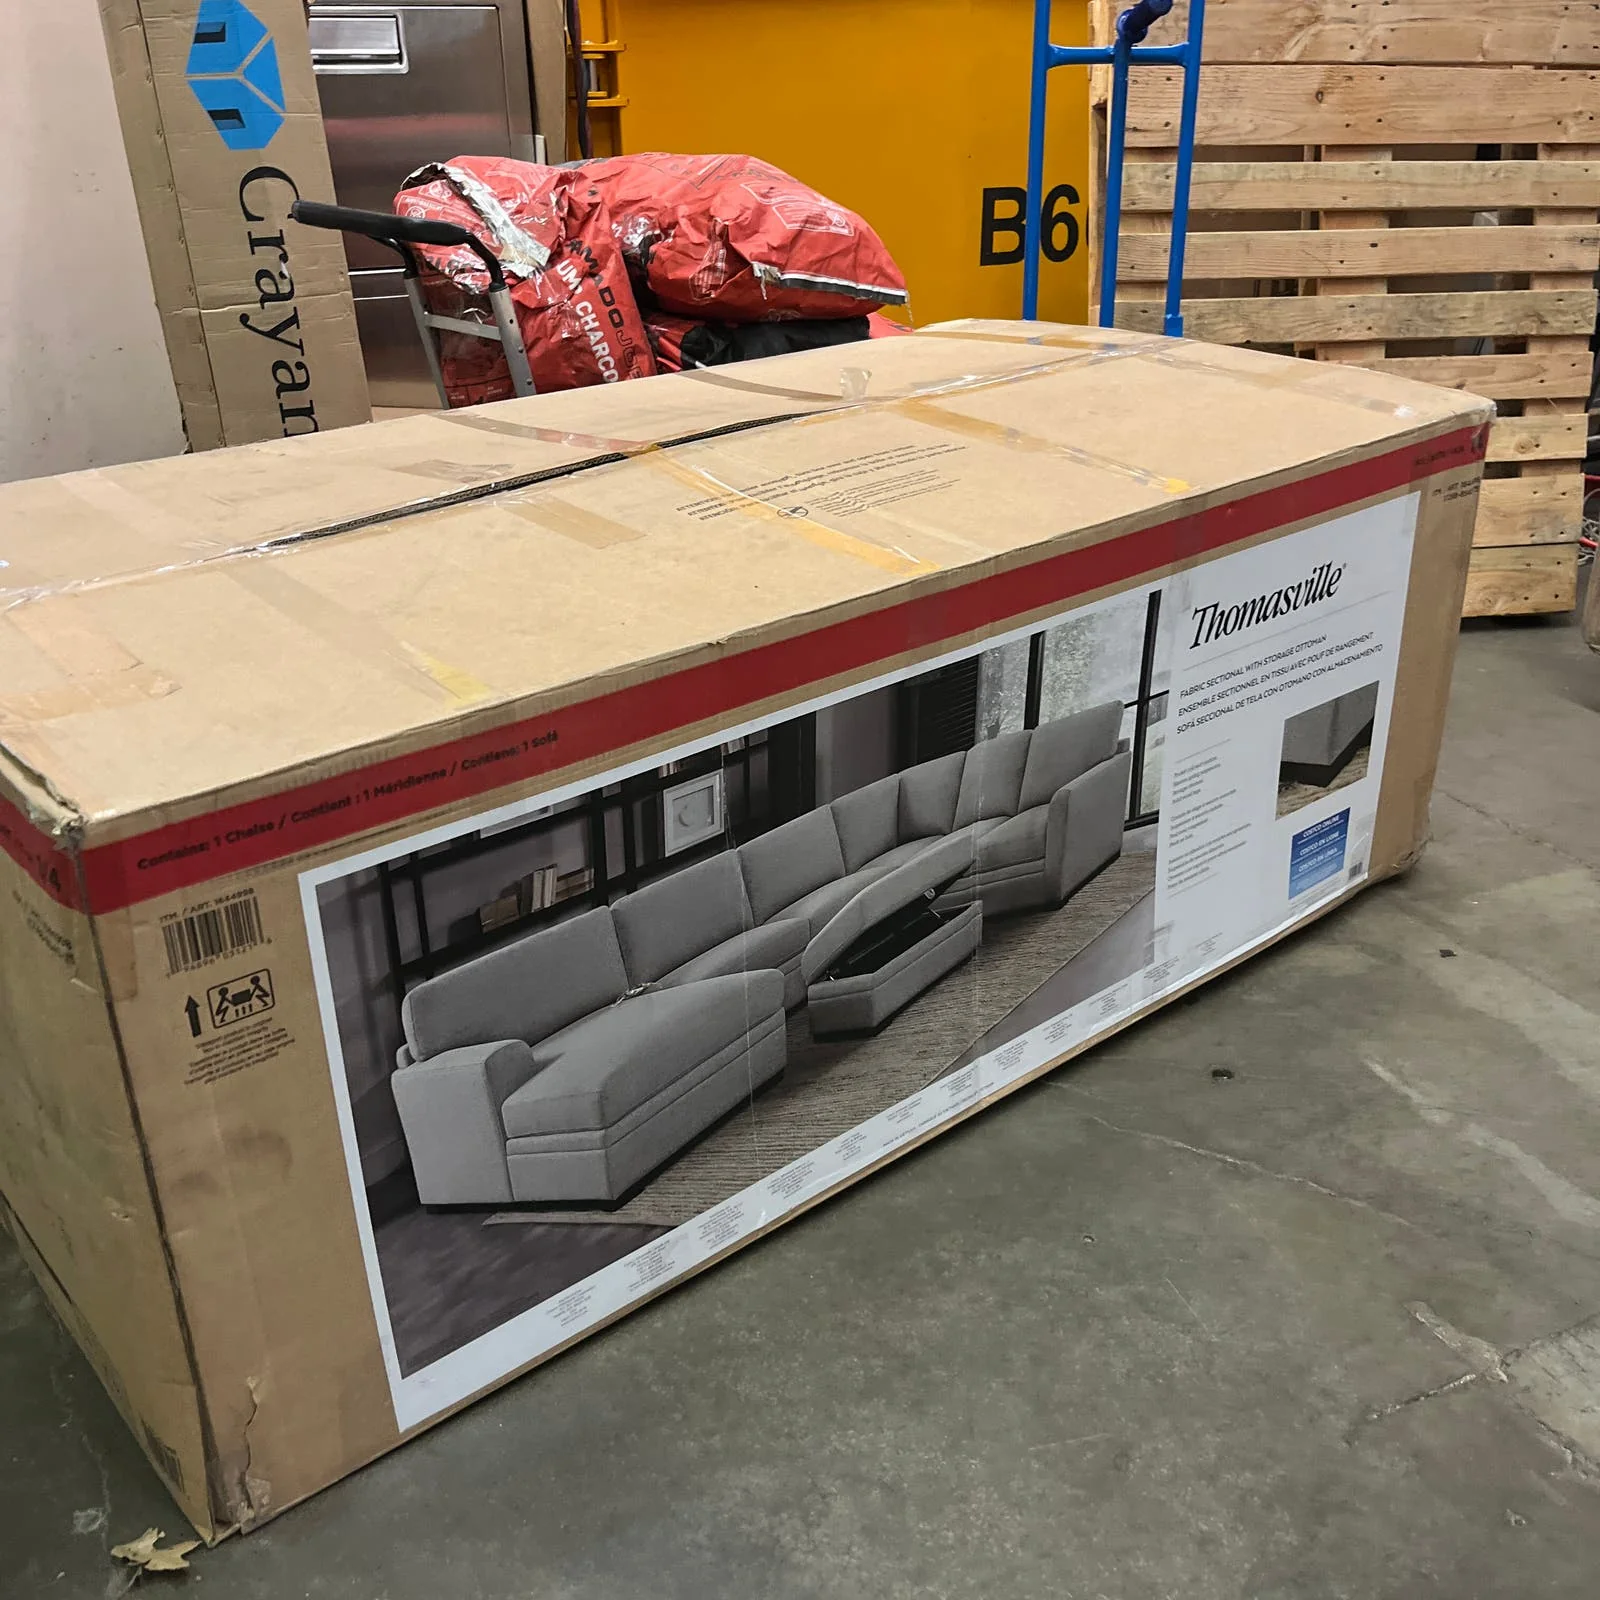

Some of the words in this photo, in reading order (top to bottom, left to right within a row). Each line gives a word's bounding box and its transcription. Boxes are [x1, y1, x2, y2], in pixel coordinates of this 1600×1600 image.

[980, 184, 1089, 266] B6
[1189, 560, 1344, 649] Thomasville
[1178, 694, 1216, 716] ENSEMBLE
[1217, 678, 1259, 700] SECTIONNEL
[1260, 673, 1271, 683] EN
[1271, 666, 1290, 678] TISSU
[1290, 658, 1307, 671] AVEC
[1308, 650, 1325, 663] POUF
[1325, 647, 1335, 657] DE
[1335, 631, 1374, 652] RANGEMENT
[1180, 682, 1206, 699] FABRIC
[1206, 667, 1244, 688] SECTIONAL
[1245, 660, 1263, 672] WITH
[1263, 647, 1295, 666] STORAGE
[1295, 634, 1327, 653] OTTOMAN
[1196, 705, 1234, 726] SECCIONAL
[1235, 700, 1245, 709] DE
[1246, 693, 1263, 704] TELA
[1263, 686, 1278, 698] CON
[1279, 672, 1312, 691] OTOMANO
[1312, 666, 1327, 678] CON
[1327, 643, 1383, 671] ALMACENAMIENTO
[137, 841, 211, 869] Contains:
[225, 822, 275, 845] Chaise
[278, 814, 287, 831] /
[291, 796, 351, 823] Contient
[374, 767, 447, 797] Méridienne
[450, 761, 458, 777] /
[532, 730, 559, 749] Sofá
